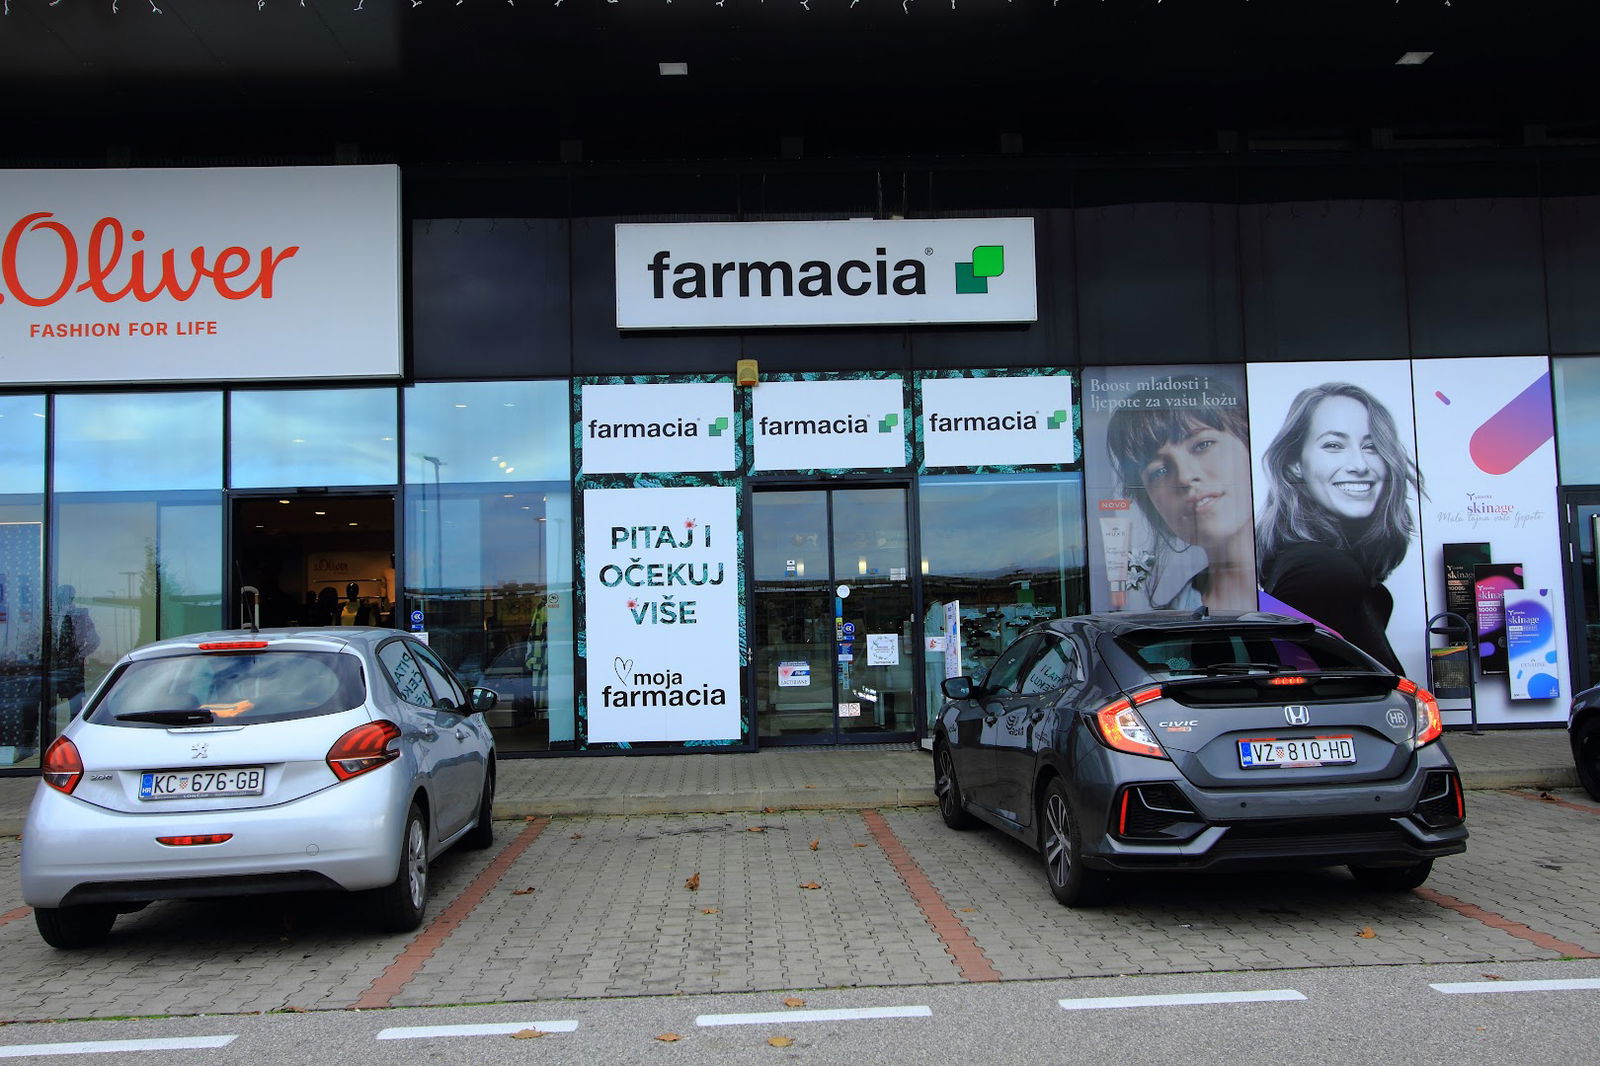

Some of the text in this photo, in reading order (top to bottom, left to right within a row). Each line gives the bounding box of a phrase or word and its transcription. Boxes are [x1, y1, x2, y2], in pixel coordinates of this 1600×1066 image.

[647, 247, 926, 299] farmacia
[30, 321, 218, 338] FASHION FOR LIFE
[1090, 376, 1209, 392] Boost mladosti i
[1091, 392, 1237, 412] ljepote za vašu kožu
[588, 418, 698, 439] farmacia
[758, 415, 868, 436] farmacia
[928, 411, 1037, 432] farmacia
[1466, 502, 1514, 515] skinage
[611, 524, 711, 550] PITAJ I
[598, 557, 724, 588] OČEKUJ
[630, 594, 697, 625] VIŠE
[1508, 615, 1540, 625] skinage
[633, 670, 683, 690] moja
[601, 683, 726, 708] farmacia
[1159, 720, 1199, 728] CIVIC
[1390, 712, 1405, 724] HR
[1253, 740, 1352, 762] VZ 810-HD
[153, 771, 259, 794] KC 676-GB
